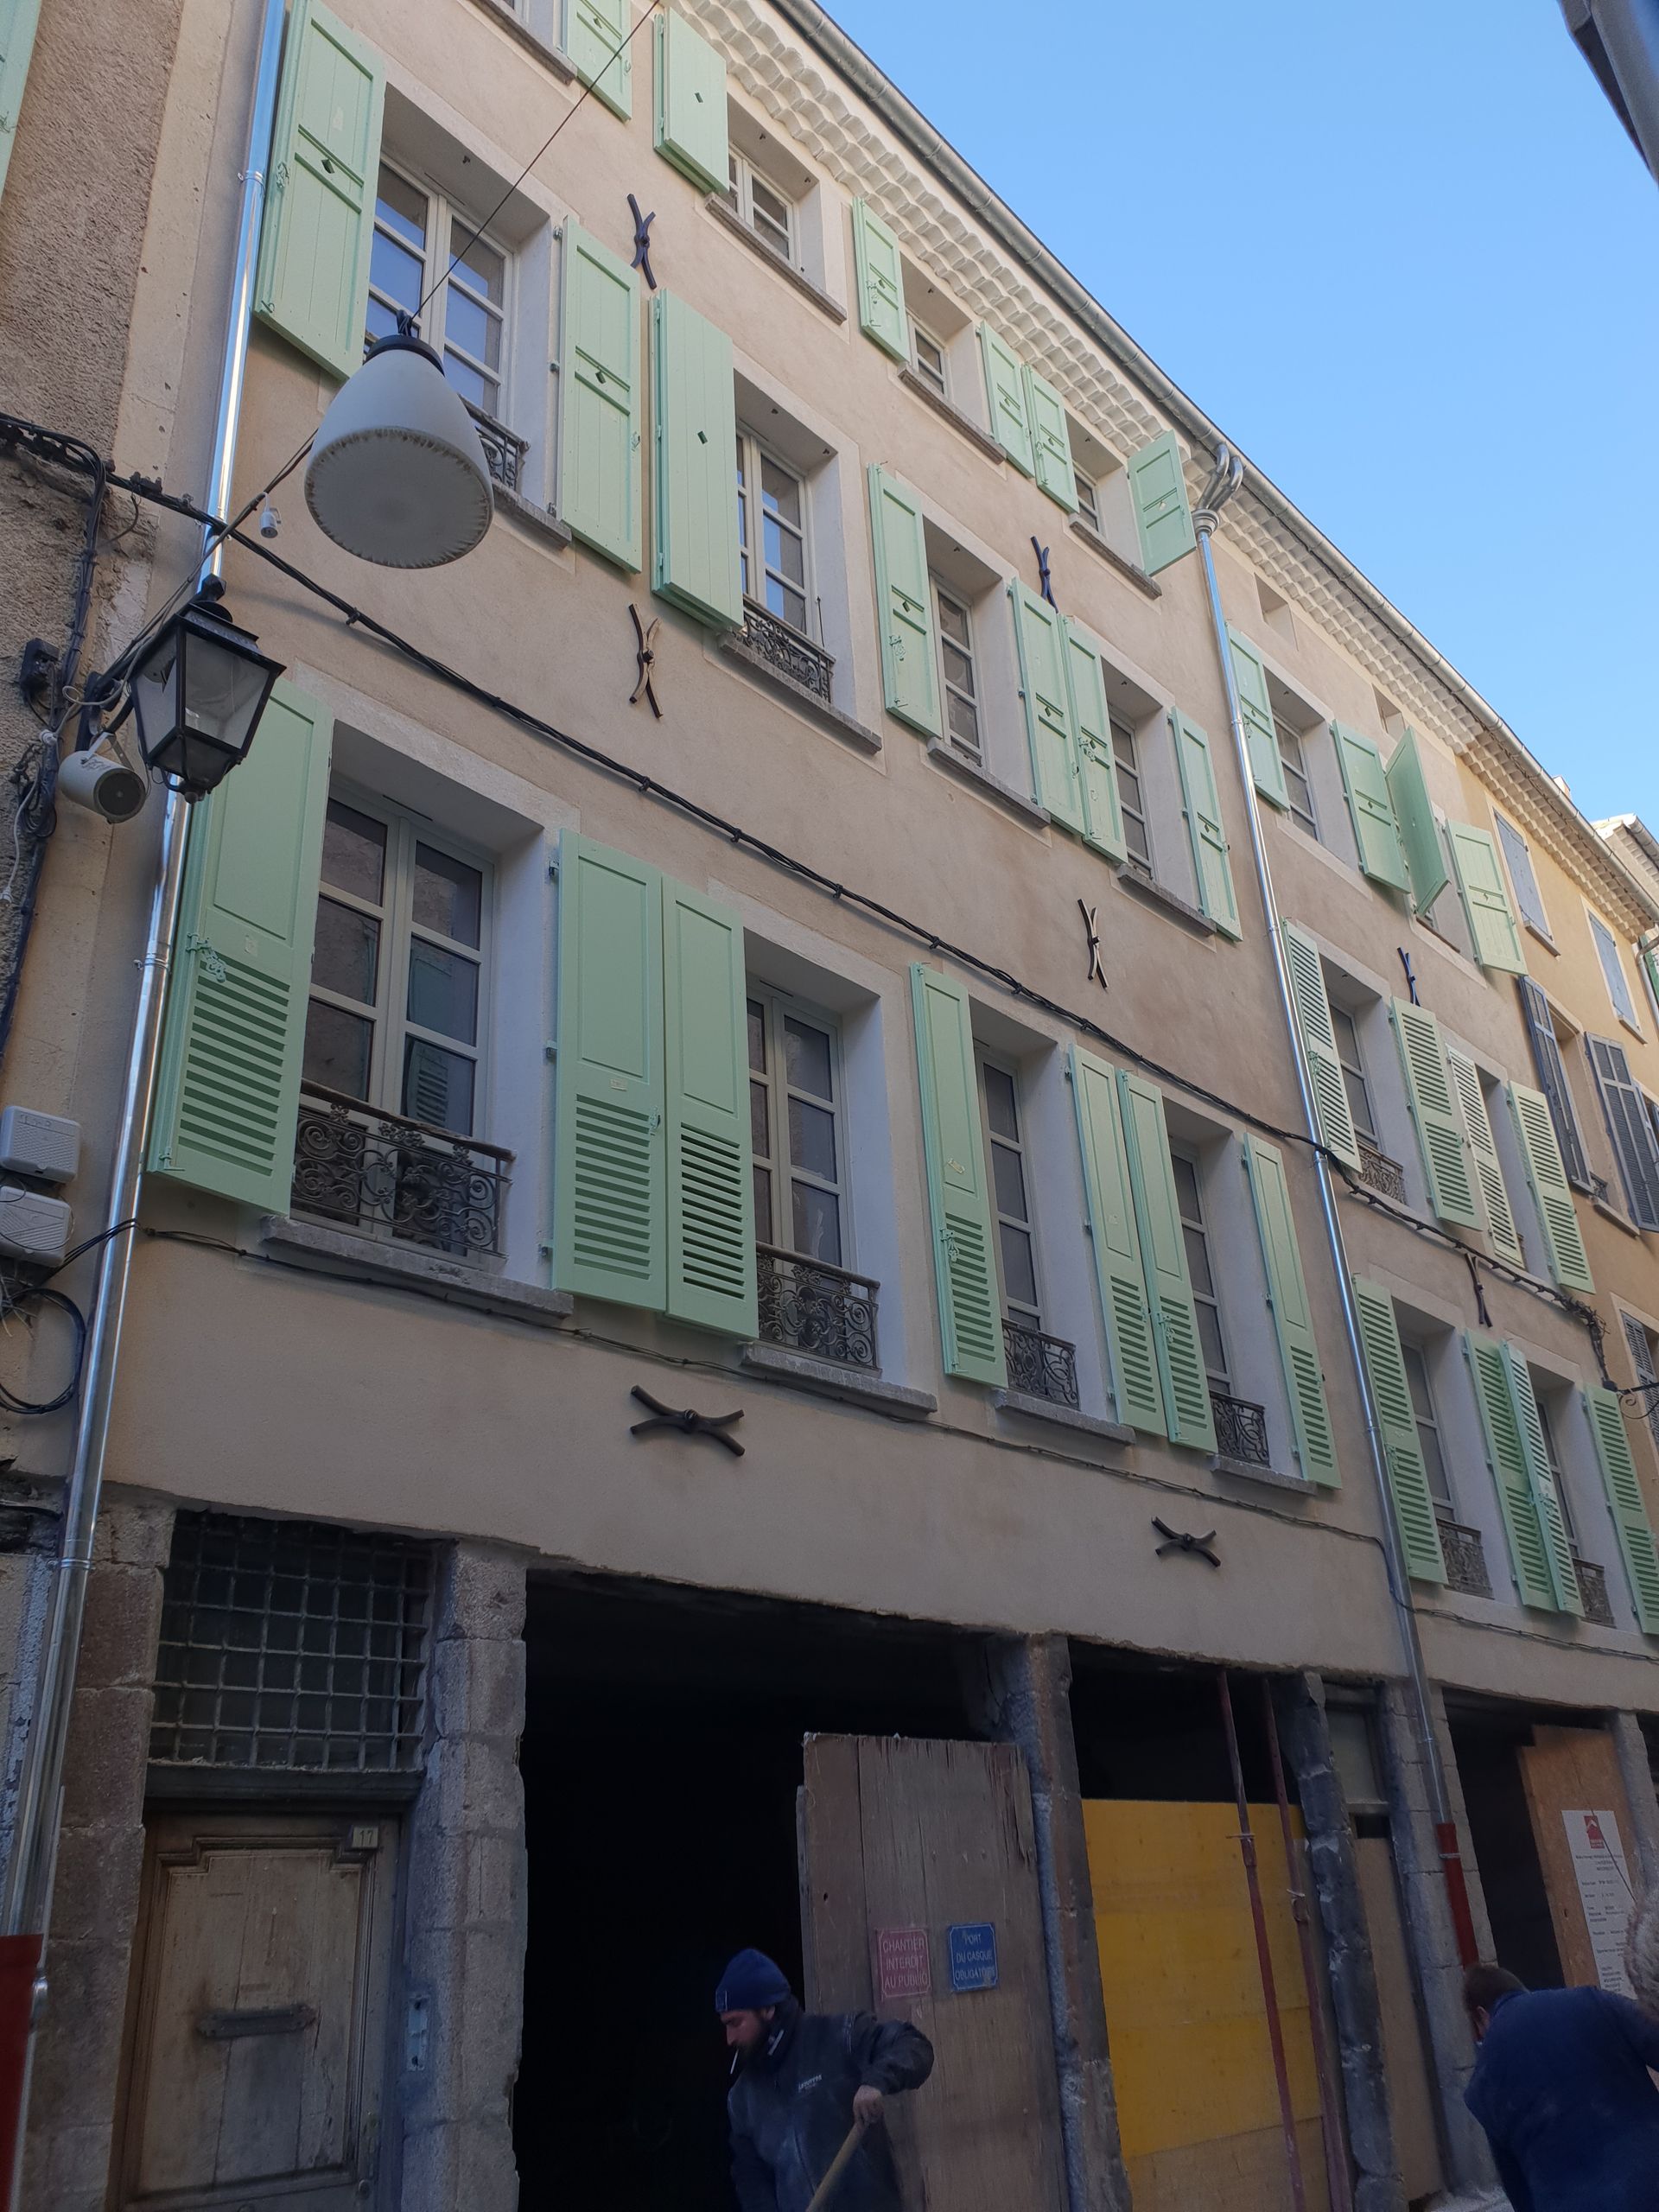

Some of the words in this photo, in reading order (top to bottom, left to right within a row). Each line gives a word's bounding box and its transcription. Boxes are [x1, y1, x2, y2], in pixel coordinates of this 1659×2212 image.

[359, 1830, 373, 1846] 17
[882, 1936, 925, 1953] CHANTIER
[964, 1934, 982, 1945] PORT
[886, 1955, 923, 1970] INTERDIT
[956, 1953, 966, 1964] DU
[967, 1950, 993, 1961] CASQUE
[885, 1975, 895, 1989] AU
[899, 1971, 928, 1987] PUBLIC
